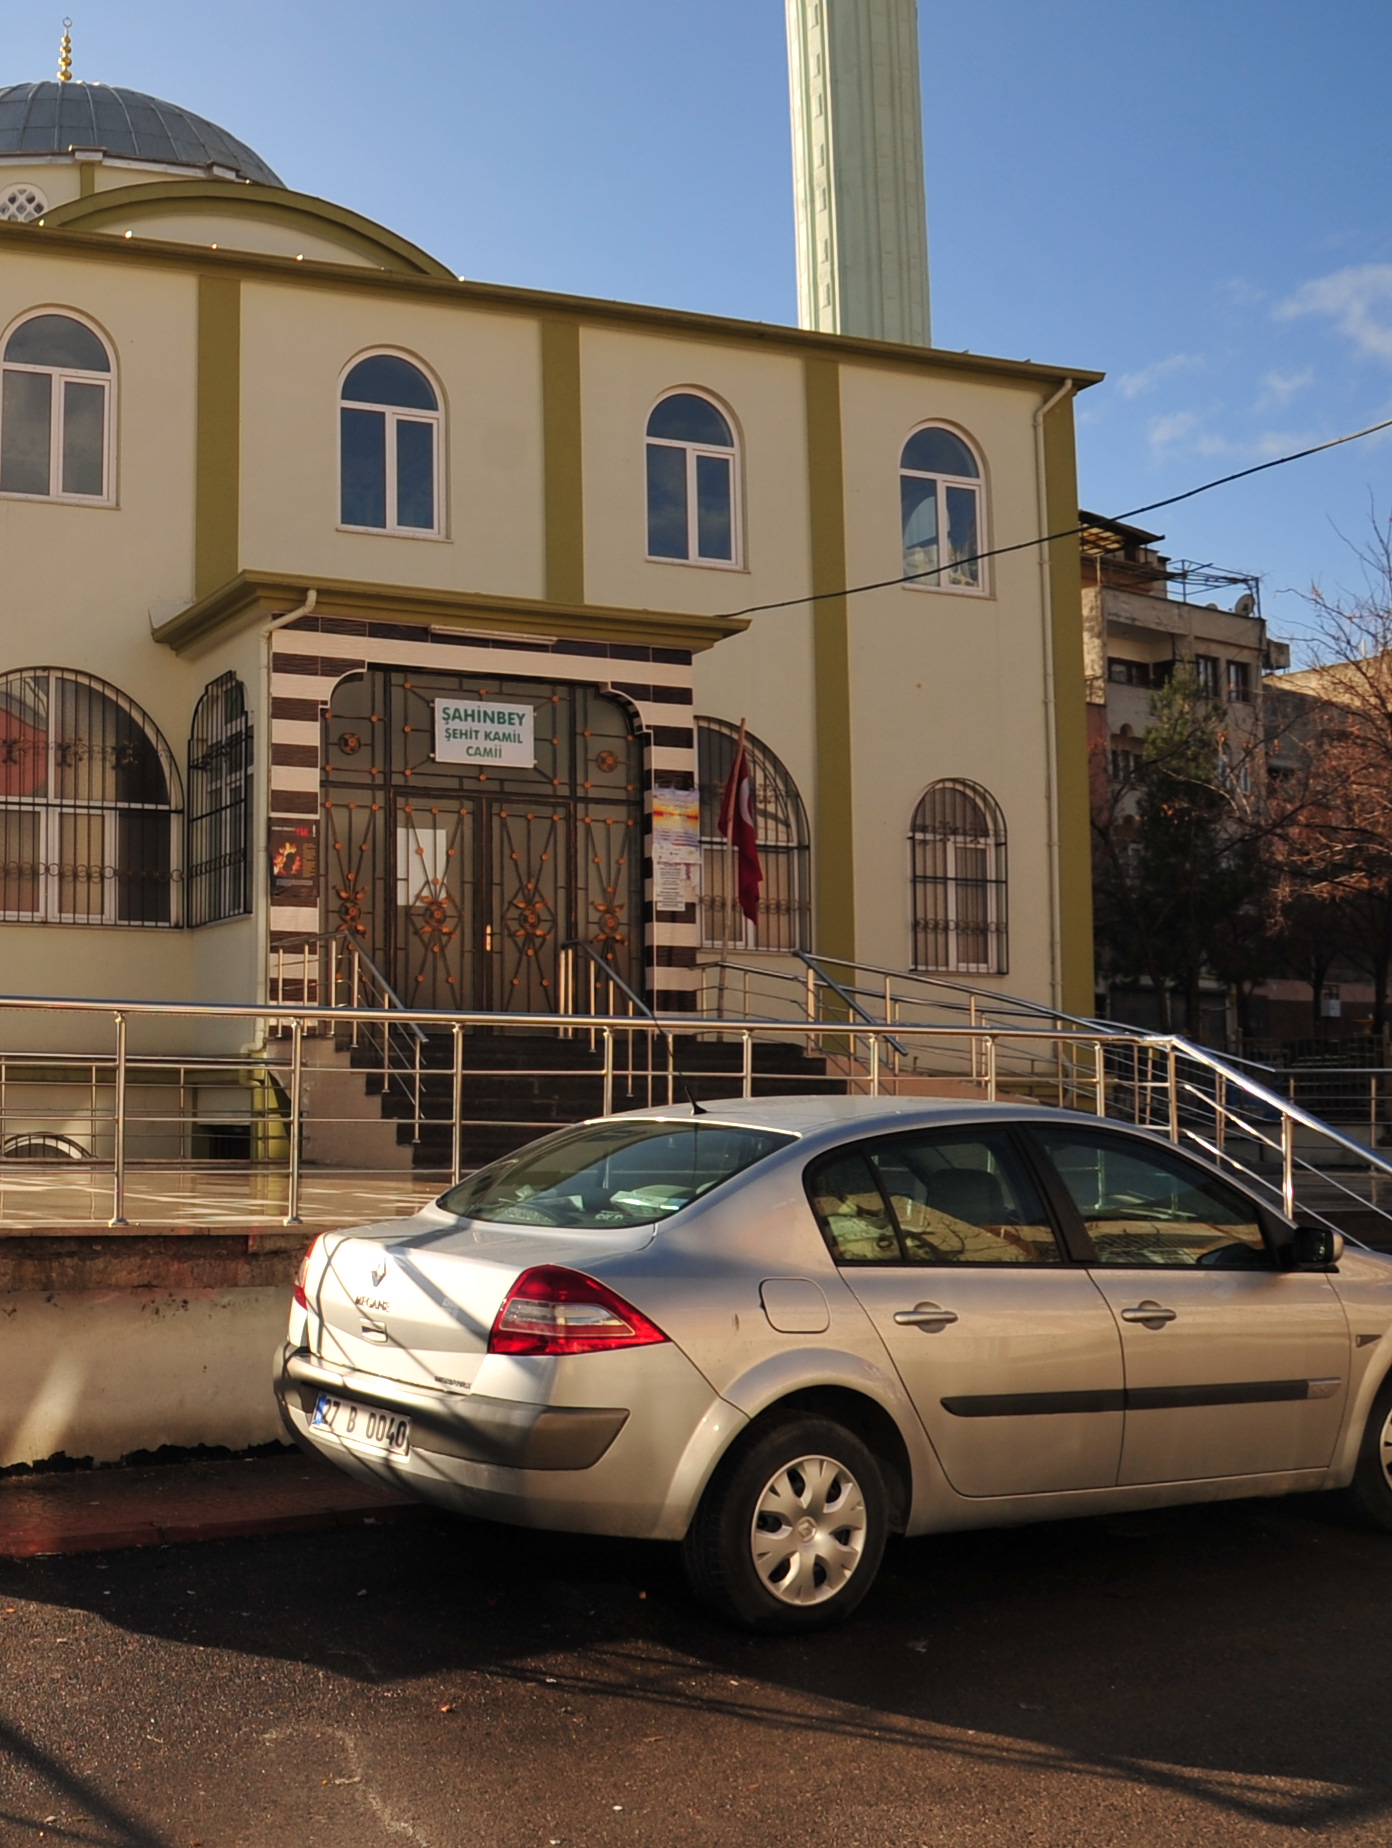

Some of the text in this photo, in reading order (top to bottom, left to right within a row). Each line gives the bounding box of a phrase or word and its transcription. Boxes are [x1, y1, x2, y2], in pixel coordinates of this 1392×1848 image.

[442, 705, 526, 726] ŞAHİNBEY
[445, 727, 523, 744] ŞEHİT KAMİL
[466, 744, 502, 759] CAMİİ
[346, 1406, 358, 1433] B
[366, 1412, 407, 1449] 0040
